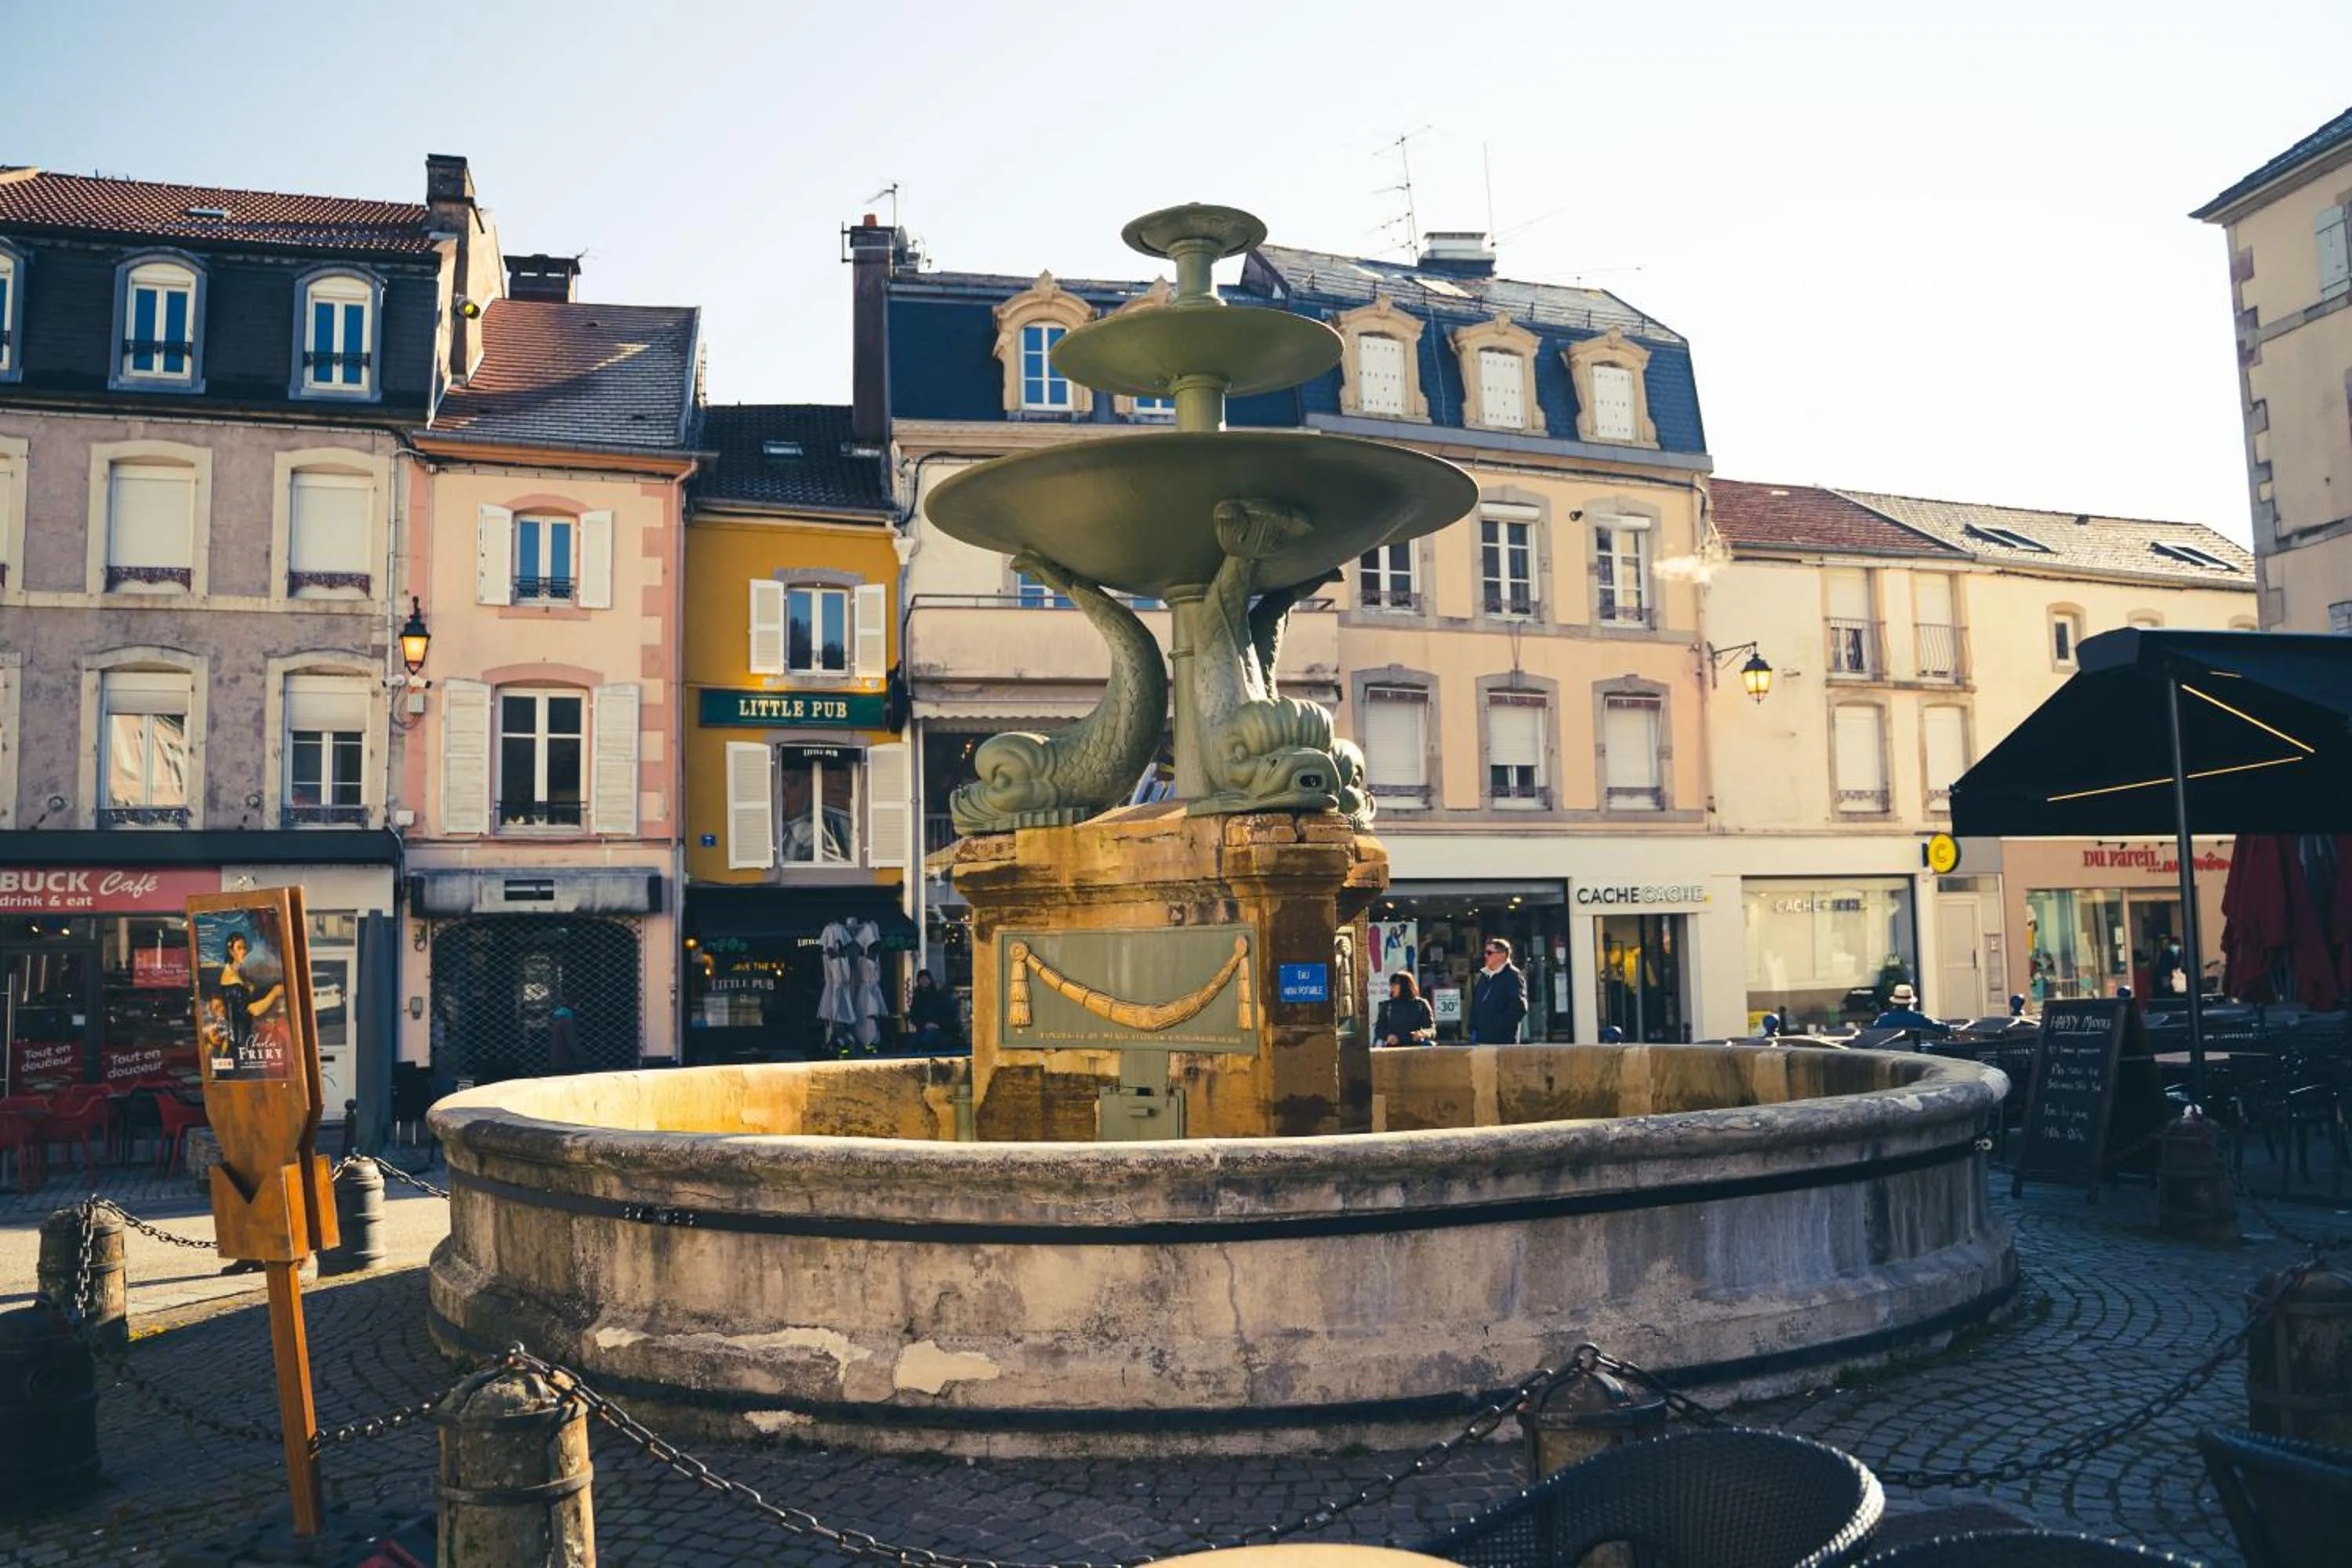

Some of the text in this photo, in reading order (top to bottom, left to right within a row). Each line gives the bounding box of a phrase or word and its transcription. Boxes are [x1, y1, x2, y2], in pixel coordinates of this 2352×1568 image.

[739, 699, 848, 718] LITTLE PUB
[0, 870, 158, 899] BUCK Café
[0, 895, 93, 907] drink & eat
[1577, 886, 1640, 904] CACHE
[25, 1044, 71, 1058] Tout en
[111, 1048, 162, 1065] Tout en
[238, 1046, 283, 1061] FRIRY
[21, 1054, 74, 1073] douceur
[107, 1060, 164, 1079] douceur
